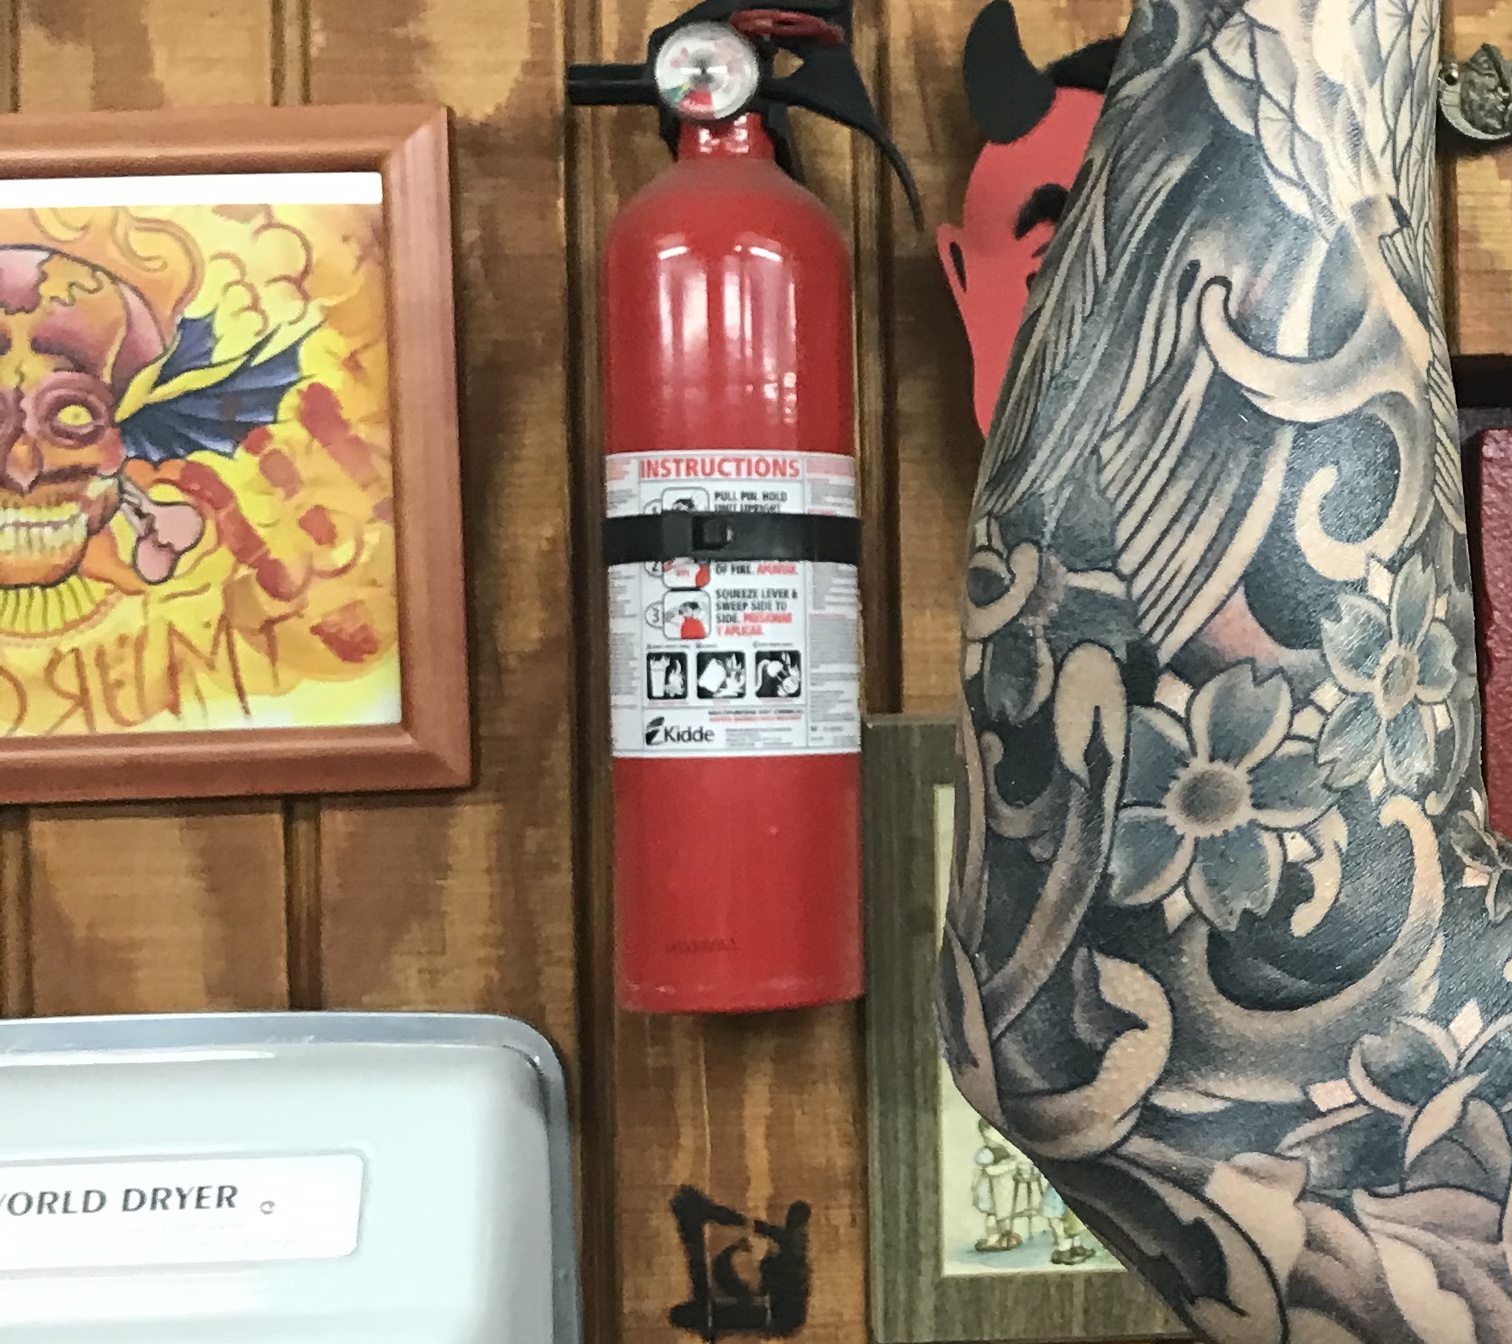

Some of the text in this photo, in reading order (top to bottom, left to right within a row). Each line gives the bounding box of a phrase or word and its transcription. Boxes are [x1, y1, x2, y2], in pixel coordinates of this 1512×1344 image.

[640, 457, 801, 478] INSTRUCTIONS
[664, 725, 715, 743] Kidde
[0, 1184, 239, 1216] ORLD DRYER
